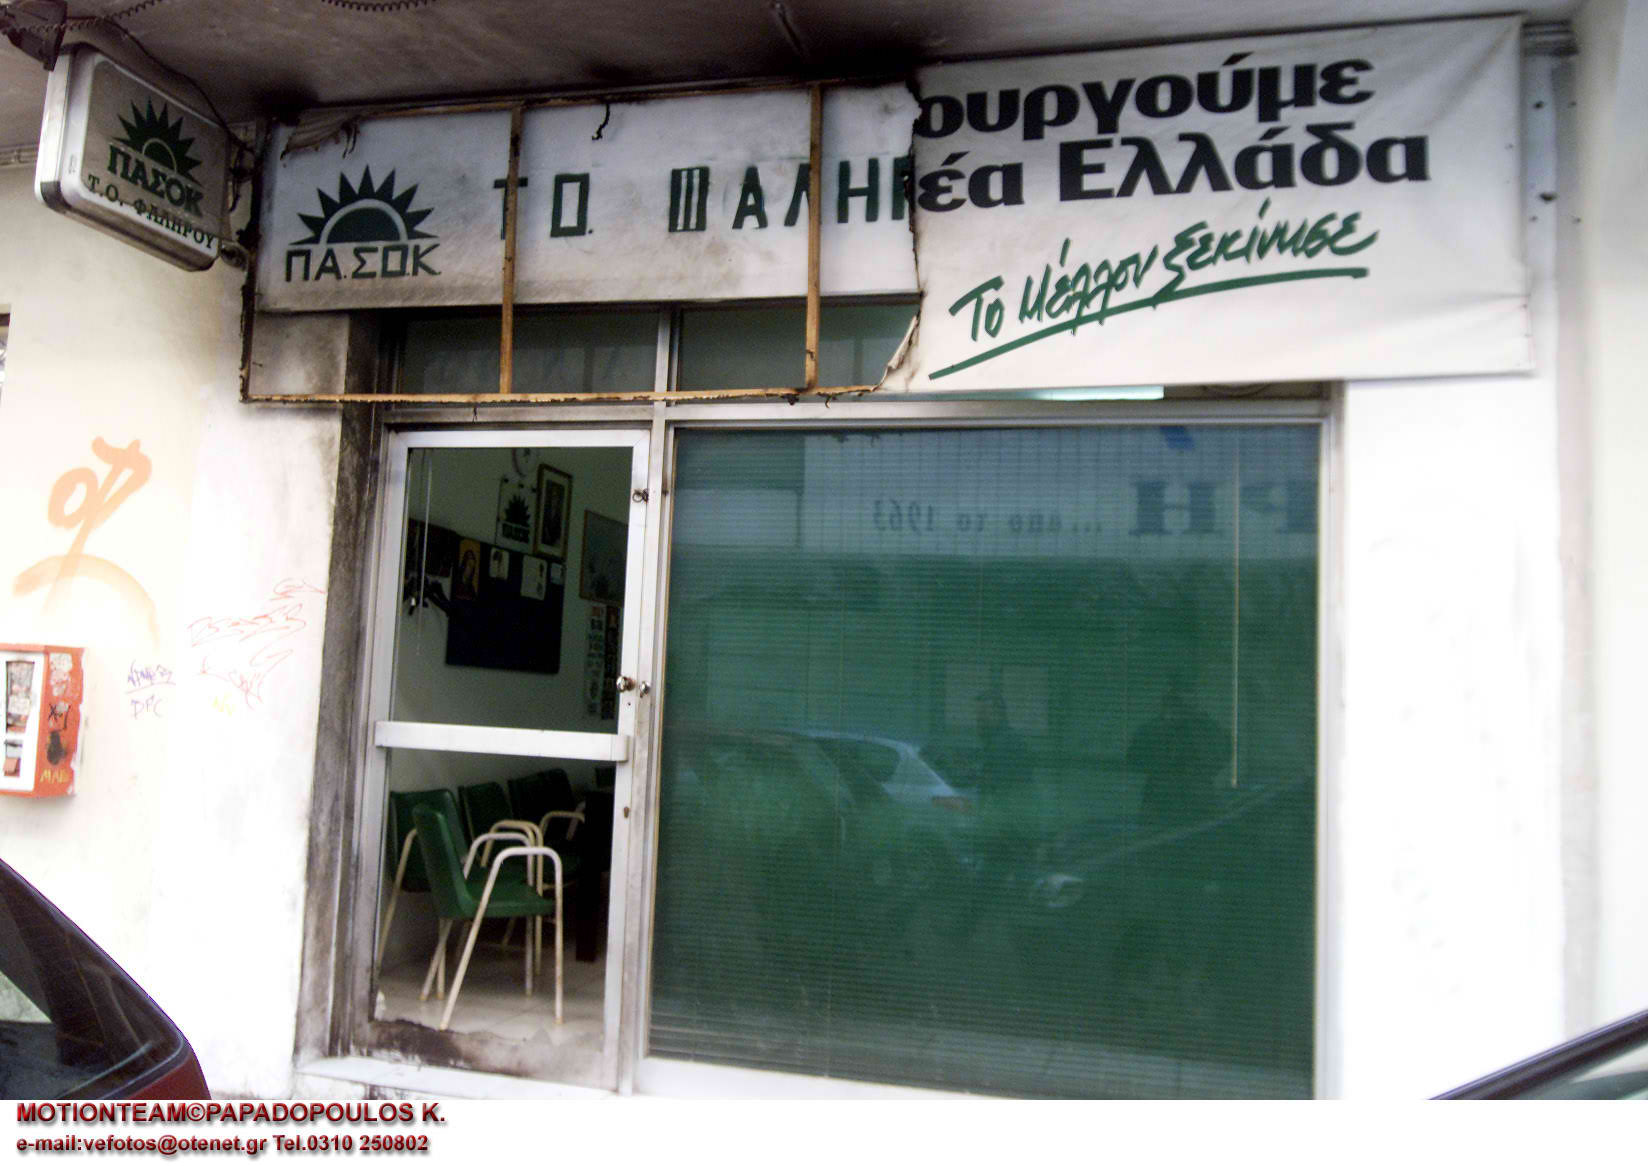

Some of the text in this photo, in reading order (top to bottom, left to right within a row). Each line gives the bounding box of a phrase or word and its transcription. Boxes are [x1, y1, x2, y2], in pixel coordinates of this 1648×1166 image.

[108, 143, 203, 217] ΠΑΣΟΚ
[1059, 121, 1431, 202] Ελλάδα
[948, 275, 1005, 342] Το
